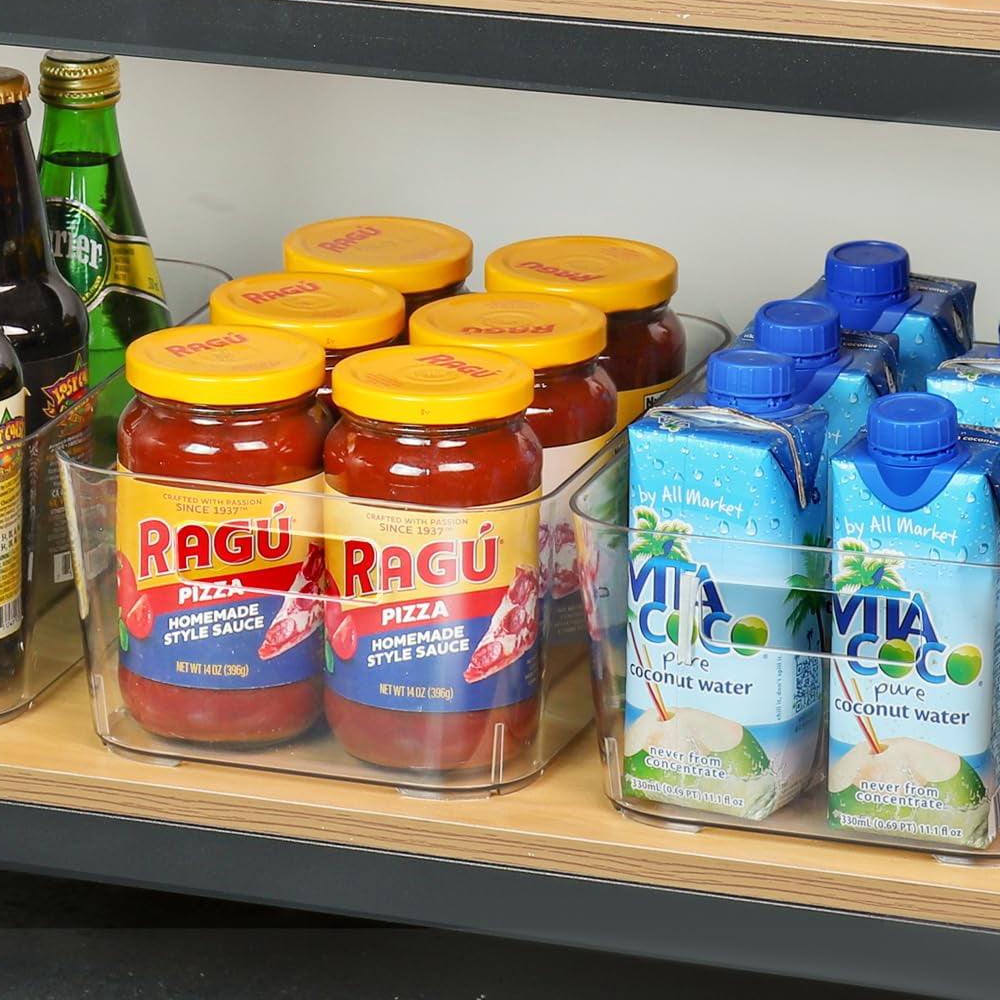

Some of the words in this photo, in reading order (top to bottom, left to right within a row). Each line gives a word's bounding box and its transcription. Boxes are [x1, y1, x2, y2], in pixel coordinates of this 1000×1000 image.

[241, 279, 322, 306] RAGÚ
[165, 331, 249, 359] RAGÚ
[162, 492, 199, 504] CRAFTED
[200, 497, 224, 506] WITH
[226, 497, 263, 506] PASSION
[176, 502, 210, 515] SINCE
[638, 484, 657, 508] by
[661, 485, 683, 505] All
[685, 488, 745, 519] Market
[379, 523, 414, 535] SINCE
[404, 517, 429, 526] WITH
[430, 517, 469, 527] PASSION
[844, 516, 864, 540] by
[869, 516, 893, 535] All
[897, 517, 959, 547] Market
[137, 500, 293, 581] RAGÚ
[343, 519, 500, 599] RAGÚ
[178, 578, 245, 605] PIZZA
[629, 552, 727, 619] VITA
[167, 602, 260, 631] HOMEMADE
[381, 599, 450, 626] PIZZA
[832, 588, 939, 643] VITA
[163, 624, 210, 646] STYLE
[211, 615, 265, 638] SAUCE
[371, 624, 466, 653] HOMEMADE
[366, 646, 414, 668] STYLE
[415, 638, 470, 660] SAUCE
[847, 632, 982, 687] COCO
[176, 660, 190, 673] NET
[190, 662, 202, 674] WT
[202, 662, 212, 675] 14
[211, 663, 223, 676] OZ
[223, 662, 250, 679] (396g)
[630, 663, 694, 691] coconut
[697, 677, 754, 697] water
[379, 682, 393, 695] NET
[393, 684, 406, 697] WT
[406, 685, 416, 698] 14
[415, 685, 427, 698] OZ
[873, 681, 926, 704] pure
[834, 697, 910, 720] coconut
[914, 705, 971, 727] water
[645, 756, 727, 779] concentrate
[649, 746, 685, 760] never
[689, 751, 721, 767] from
[631, 778, 661, 792] 330mL
[732, 798, 744, 807] oz
[855, 791, 944, 810] concentrate
[860, 780, 900, 793] never
[904, 782, 939, 798] from
[841, 814, 872, 828] 330mL
[873, 820, 898, 831] (0.69
[900, 823, 917, 834] PT)
[950, 829, 962, 838] oz
